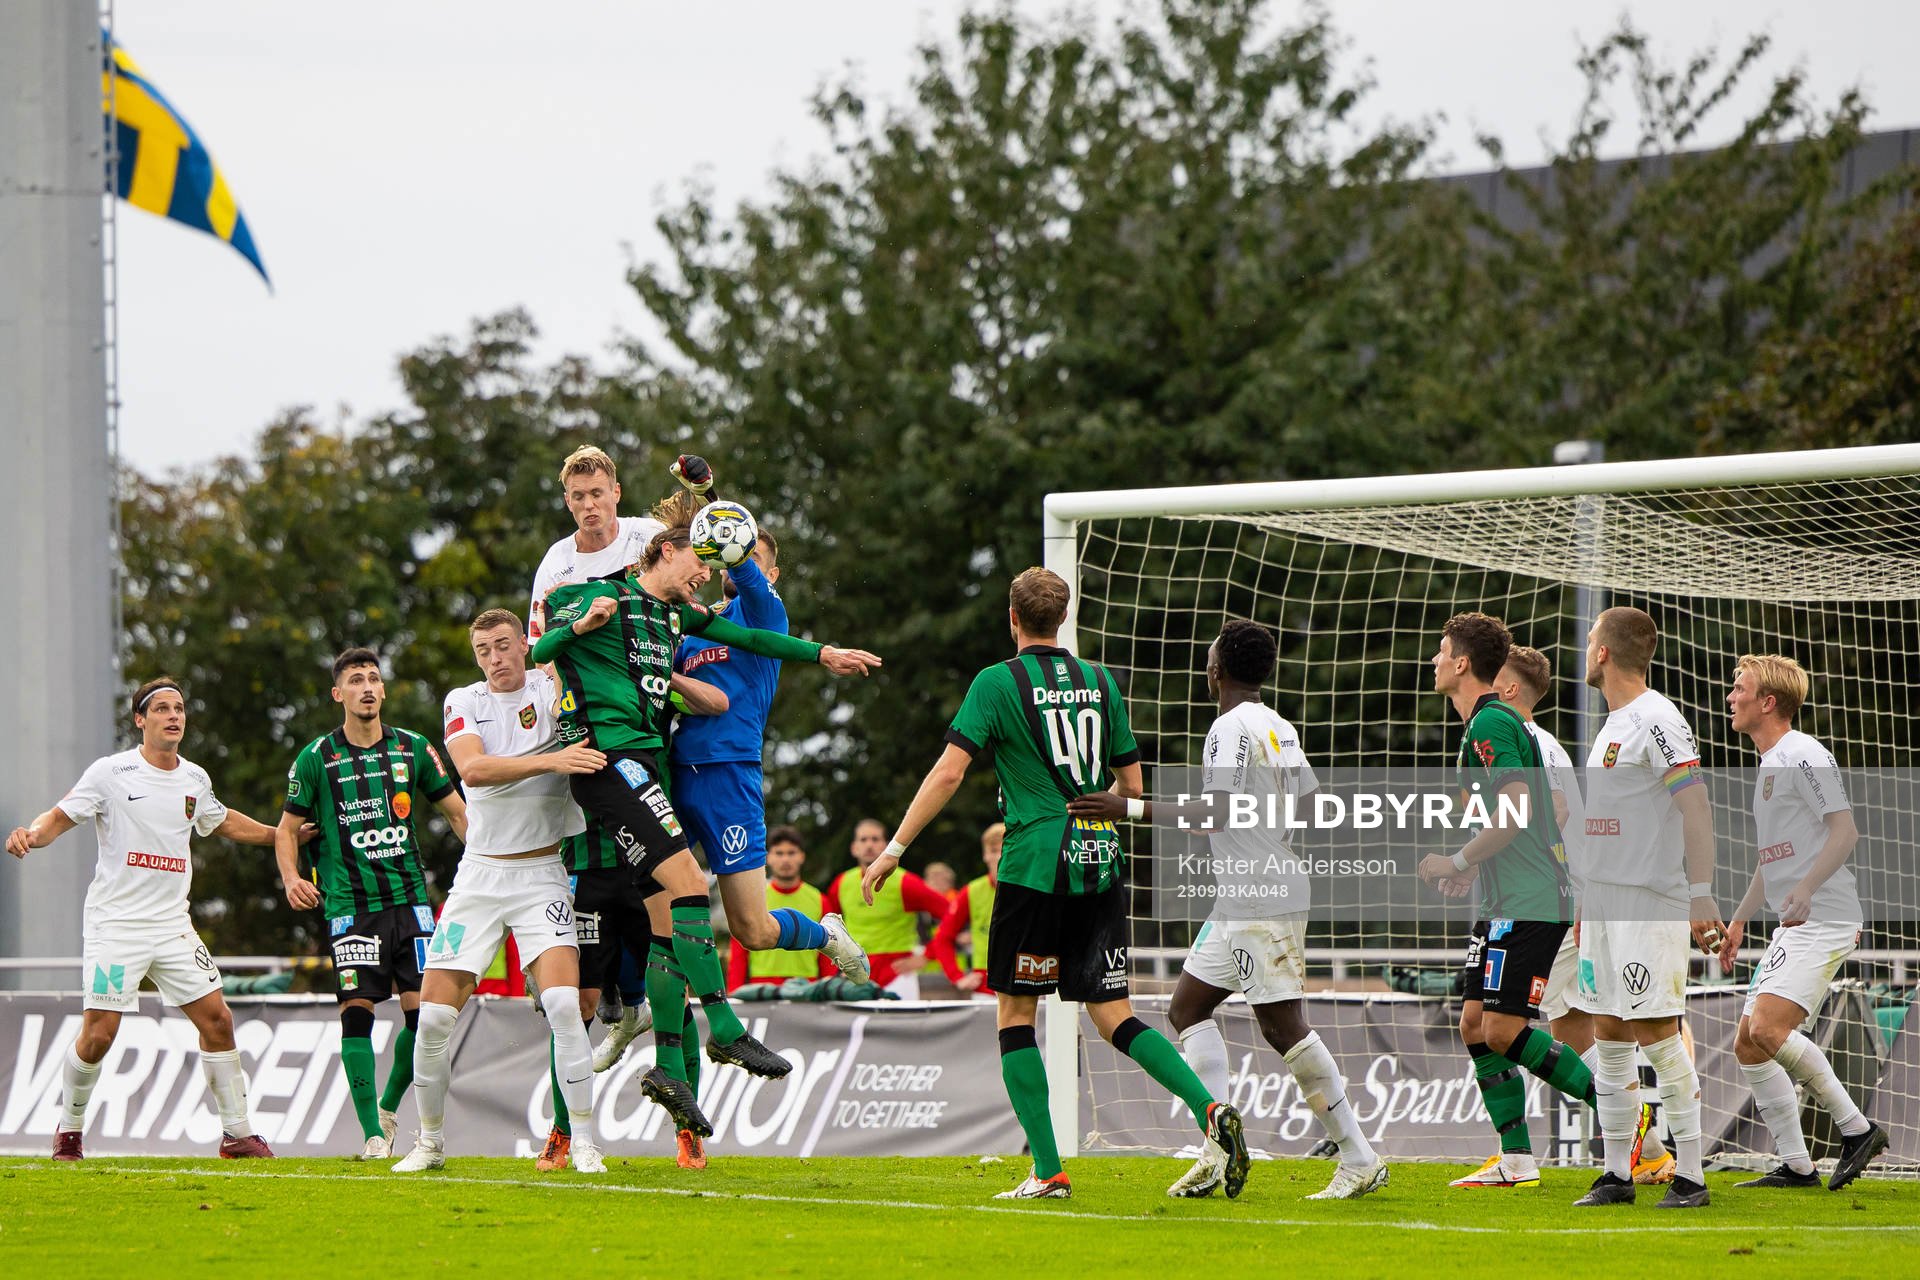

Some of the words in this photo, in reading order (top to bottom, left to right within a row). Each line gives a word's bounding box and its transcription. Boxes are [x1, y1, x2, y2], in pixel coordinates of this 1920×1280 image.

[630, 638, 670, 656] Varbergs
[629, 651, 670, 668] Sparbank
[685, 648, 728, 672] UHAUS
[1033, 686, 1102, 705] Derome
[1042, 708, 1102, 786] 40
[1650, 724, 1678, 767] stadiu
[1233, 735, 1249, 789] stadium
[1798, 759, 1827, 809] stadium
[339, 797, 383, 812] Varbergs
[338, 808, 385, 826] Sparbank
[351, 826, 409, 849] coop
[128, 853, 187, 873] BAUHAU
[335, 938, 380, 954] micael
[1018, 955, 1058, 975] FMP
[1105, 947, 1126, 969] VS
[850, 1063, 943, 1092] TOGETHER
[833, 1101, 860, 1128] TO
